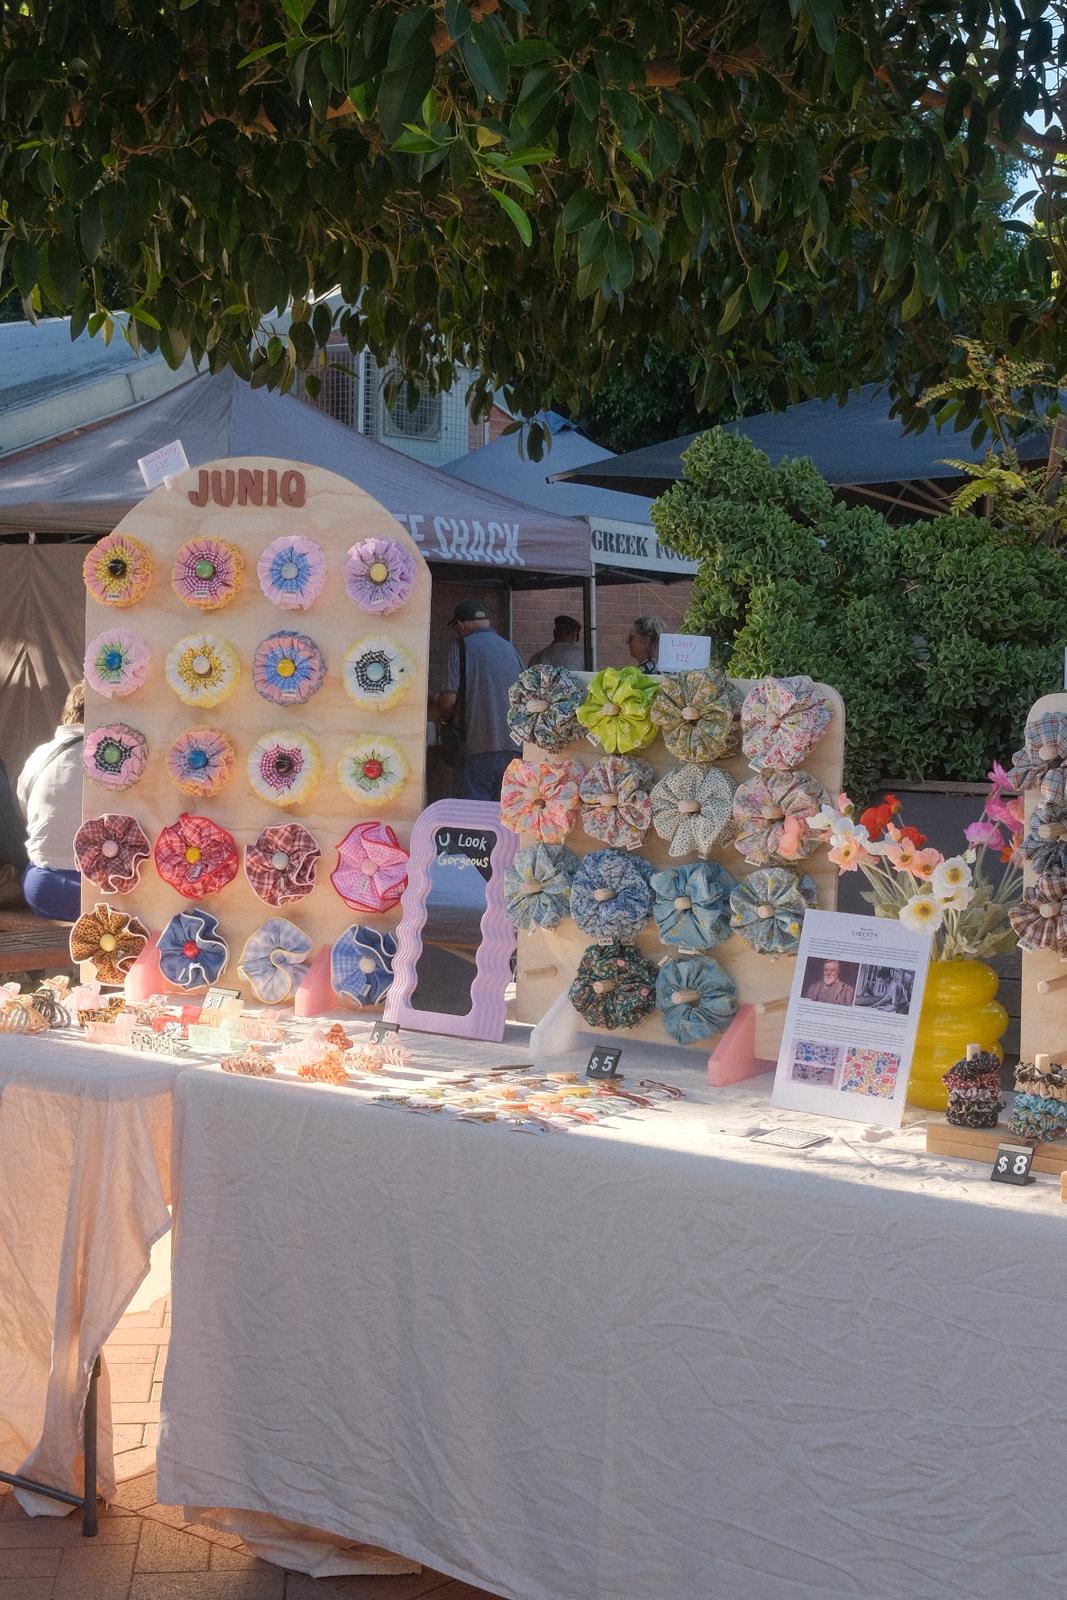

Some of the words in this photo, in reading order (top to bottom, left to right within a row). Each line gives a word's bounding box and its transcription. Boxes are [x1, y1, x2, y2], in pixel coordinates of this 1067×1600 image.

[187, 468, 307, 508] JUNIQ
[432, 516, 526, 566] SHACK
[591, 530, 649, 557] GREEK
[671, 639, 697, 652] Liberty
[438, 832, 451, 847] U
[437, 851, 489, 870] Gorgeous
[852, 929, 879, 939] LIBERTY
